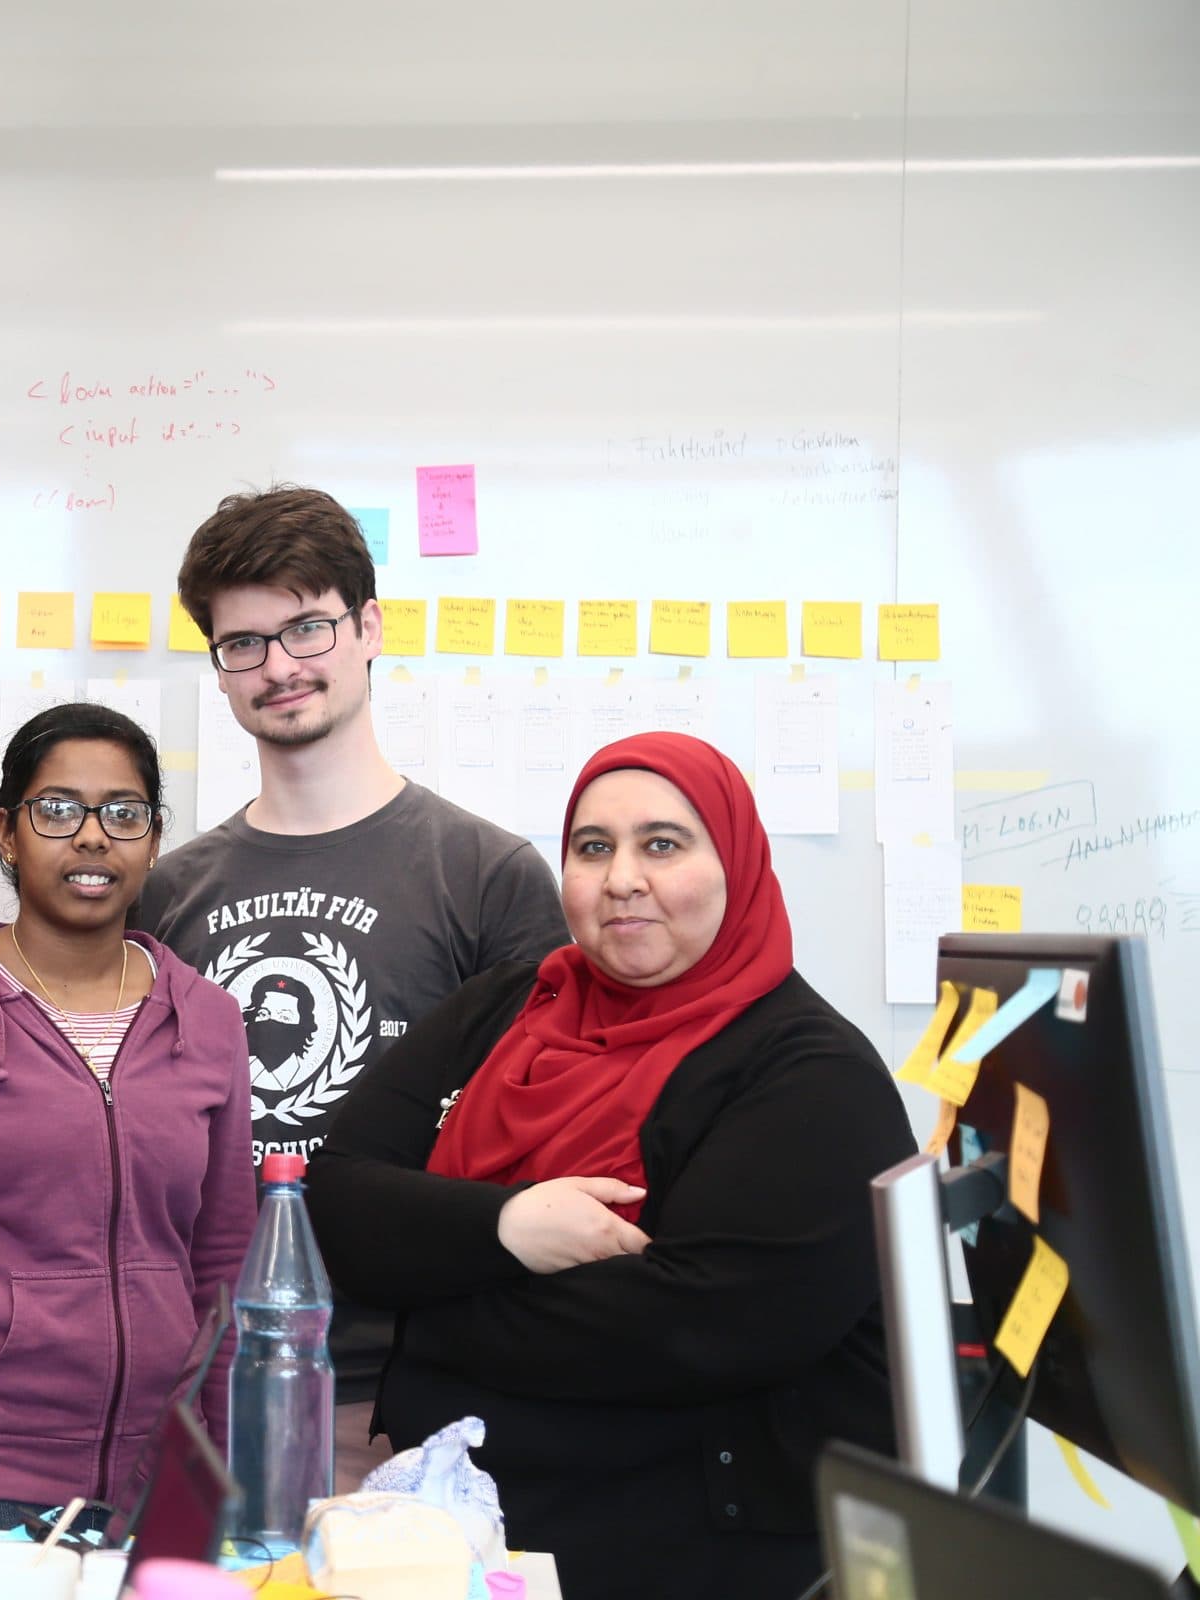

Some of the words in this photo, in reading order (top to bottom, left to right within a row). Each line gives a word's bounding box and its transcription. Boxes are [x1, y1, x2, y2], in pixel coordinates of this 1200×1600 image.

[206, 887, 326, 935] FAKULTÄT
[325, 896, 379, 934] FÜR
[379, 1019, 408, 1038] 2017
